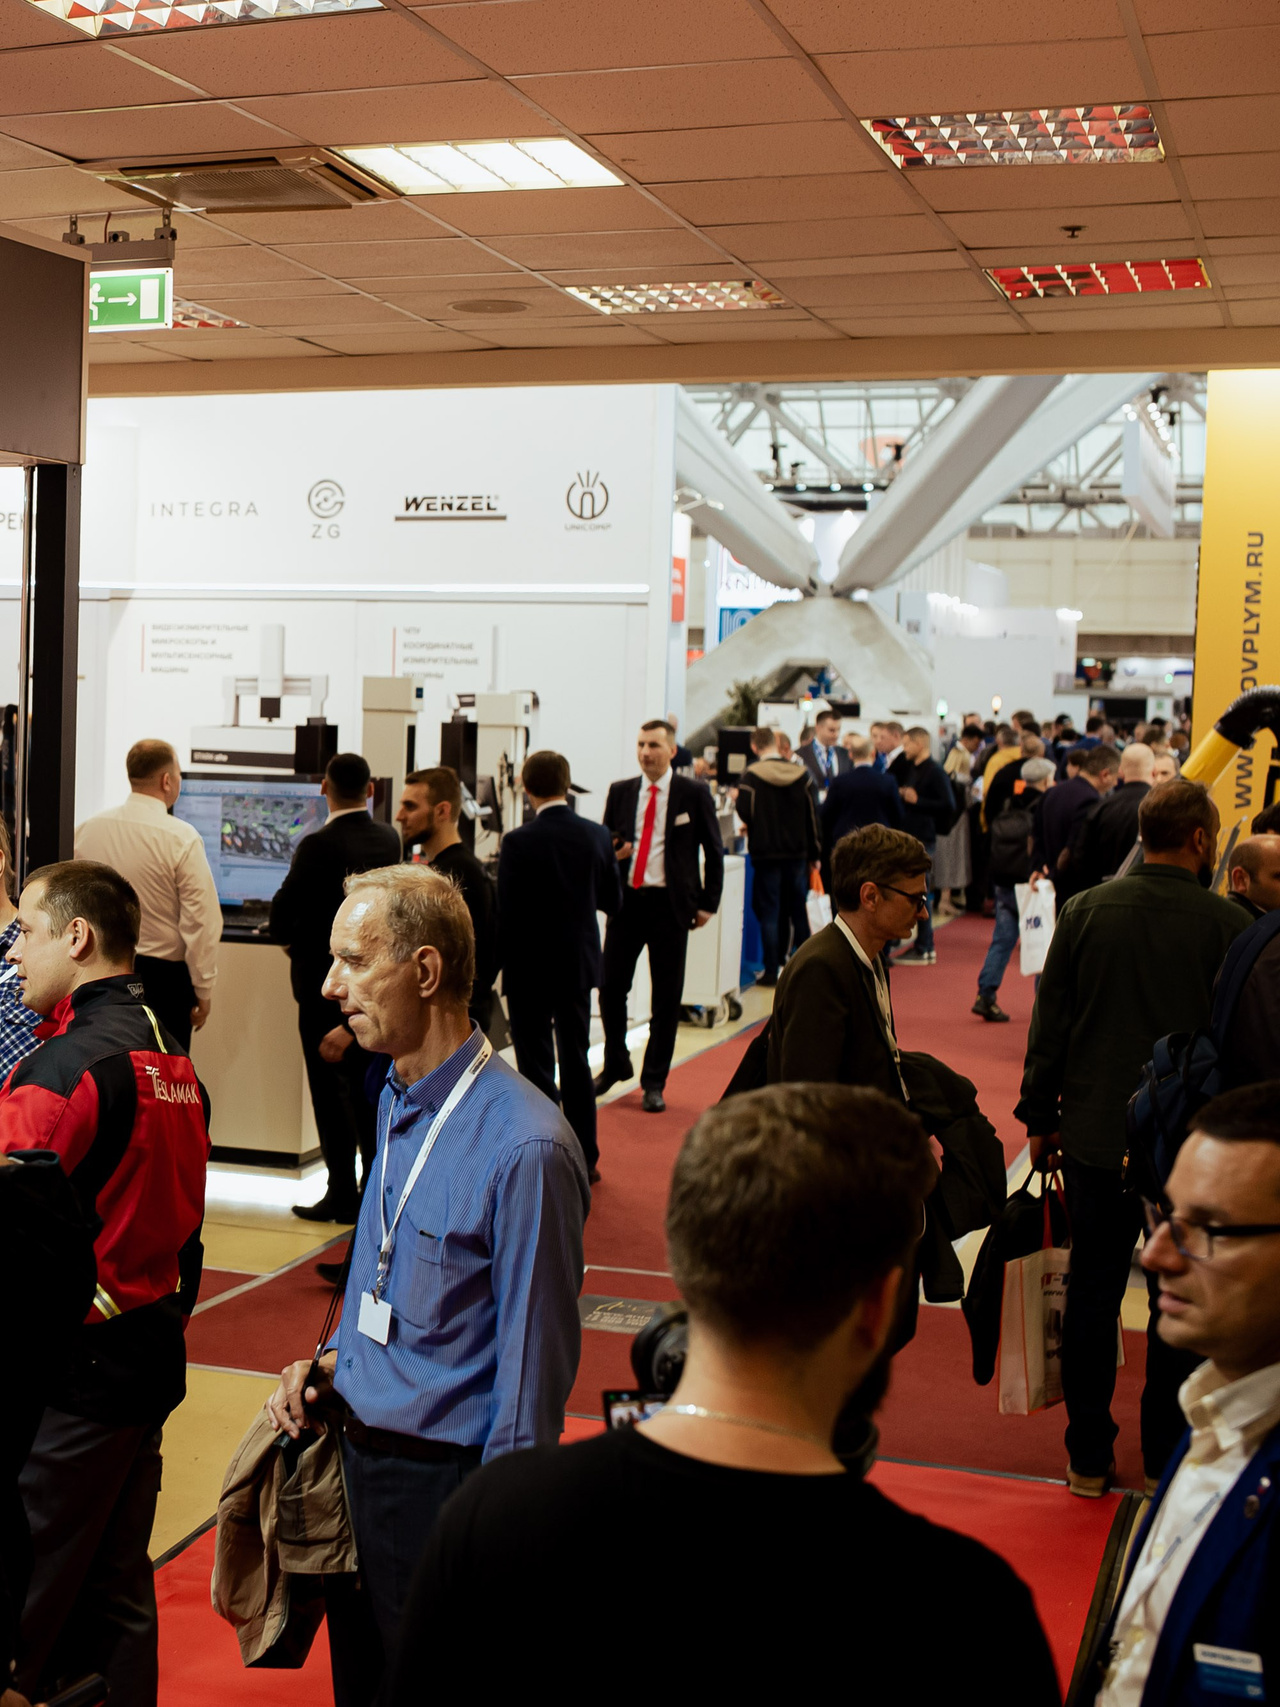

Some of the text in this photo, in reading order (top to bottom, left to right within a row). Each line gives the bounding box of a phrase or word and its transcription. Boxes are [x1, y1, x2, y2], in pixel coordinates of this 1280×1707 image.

[151, 501, 259, 517] INTEGRA
[405, 495, 498, 512] WENZEL
[145, 1065, 200, 1104] TESLAMAK
